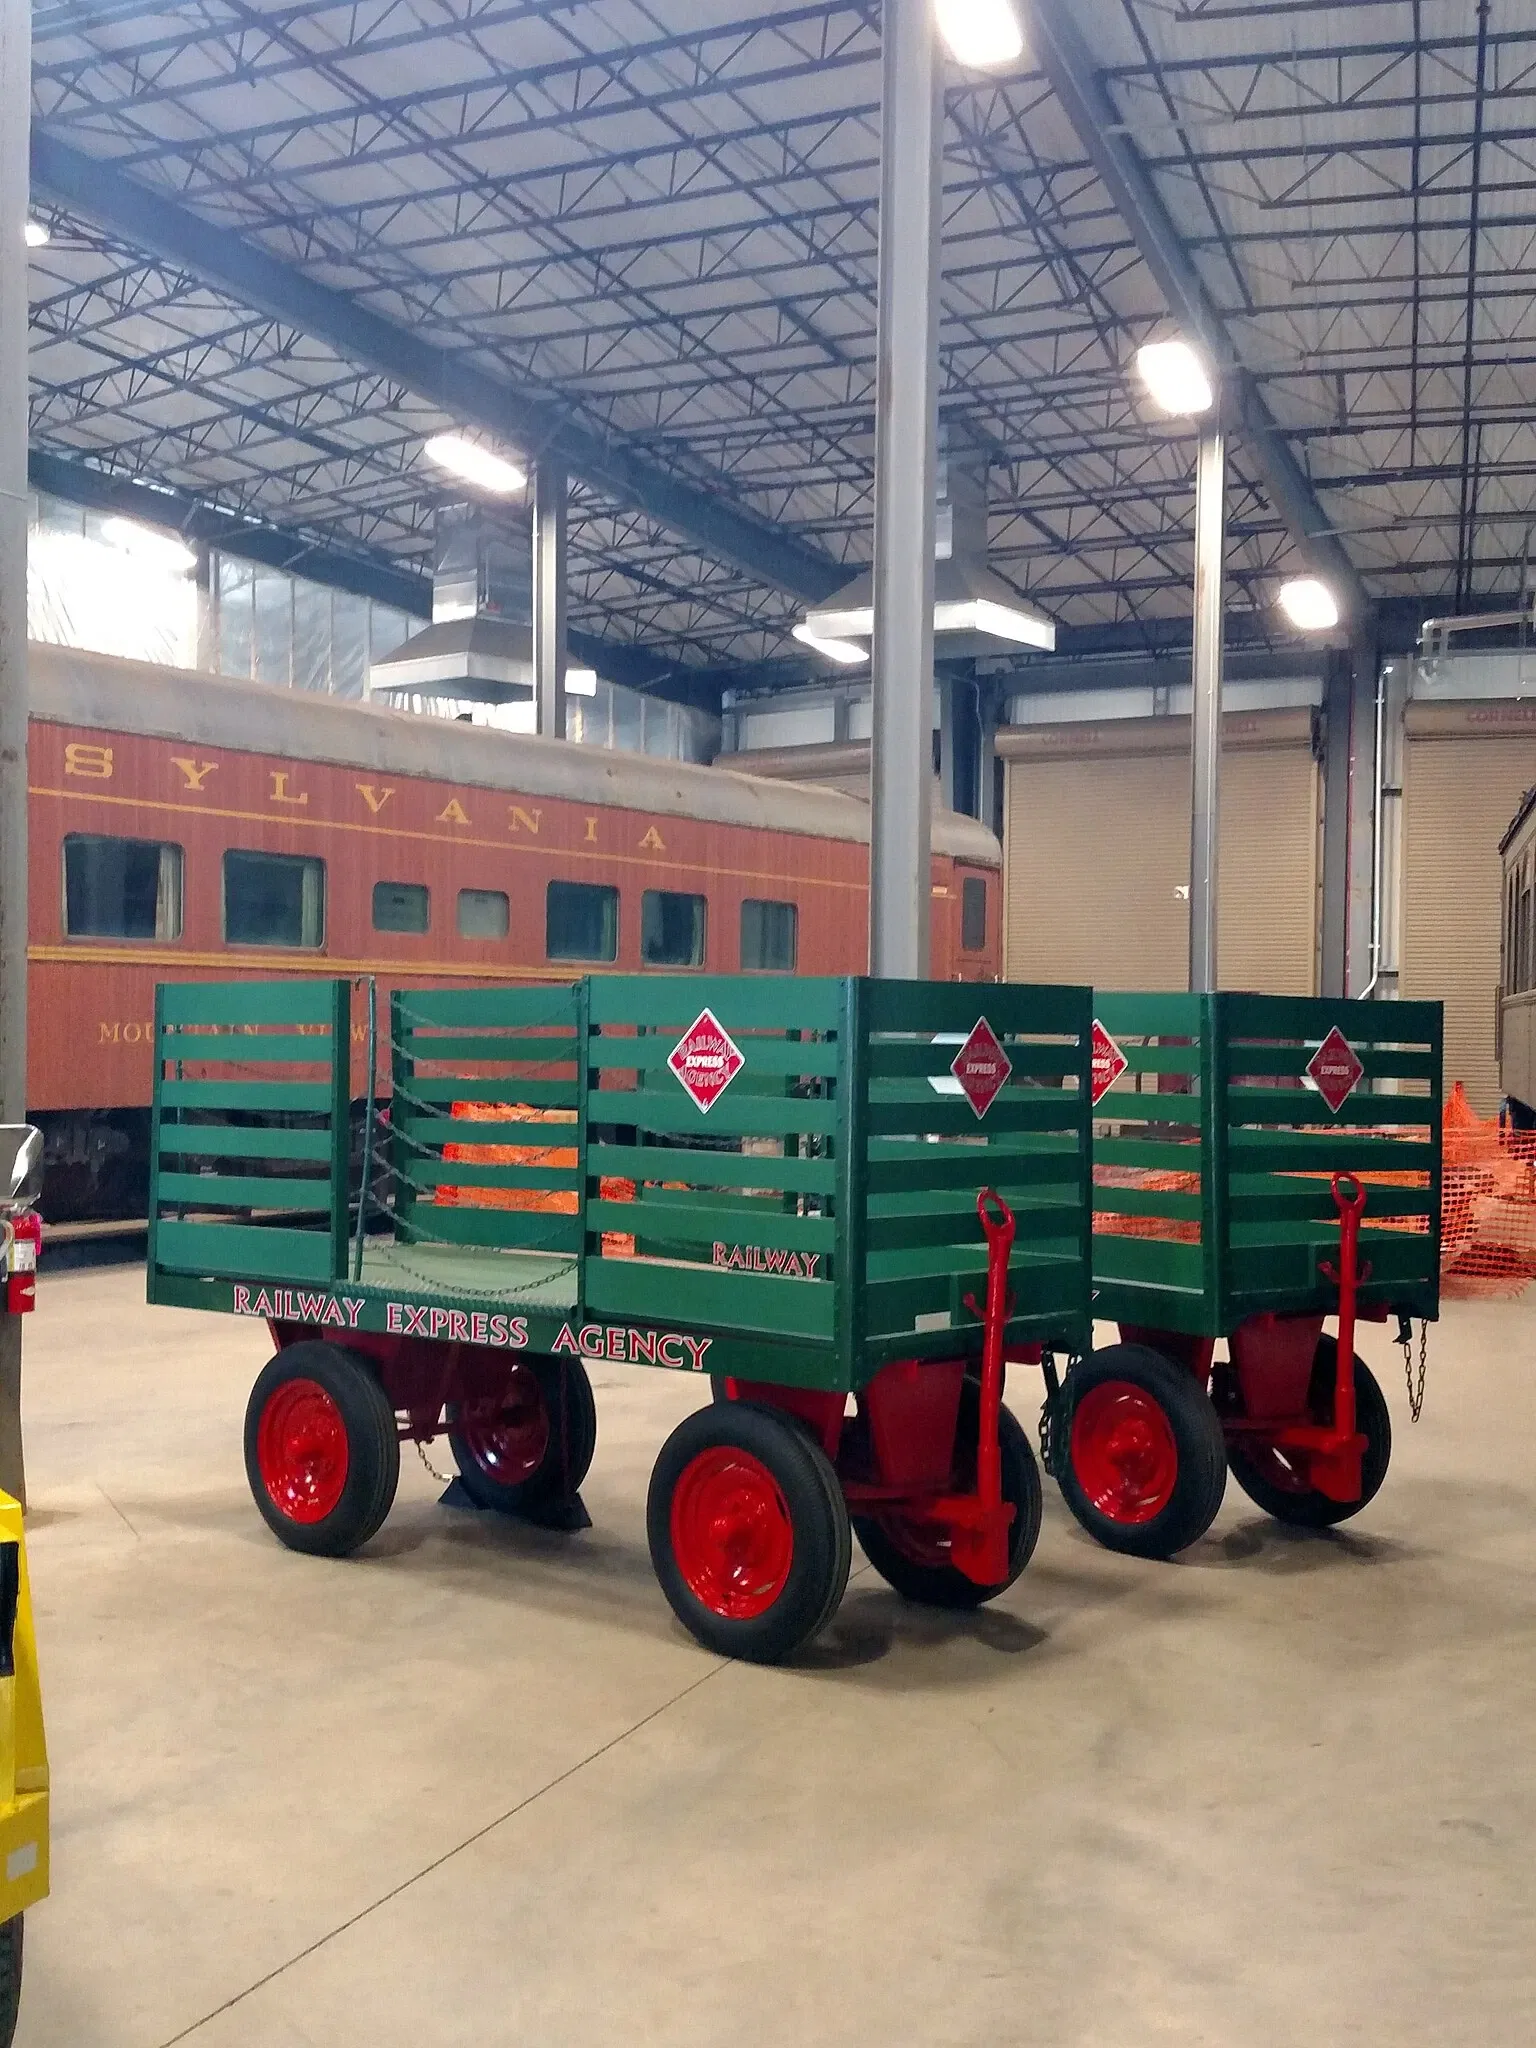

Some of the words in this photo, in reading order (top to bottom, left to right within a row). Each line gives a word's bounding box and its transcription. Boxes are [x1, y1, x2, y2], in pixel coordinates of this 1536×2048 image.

[64, 742, 667, 851] SYLVANIA
[686, 1055, 725, 1069] EXPRESS
[965, 1062, 997, 1075] EXPRESS
[1320, 1065, 1350, 1076] EXPRESS
[712, 1240, 821, 1280] RAILWAY
[232, 1284, 366, 1329] RAILWAY
[386, 1301, 529, 1348] EXPRESS
[551, 1322, 714, 1371] AGENCY
